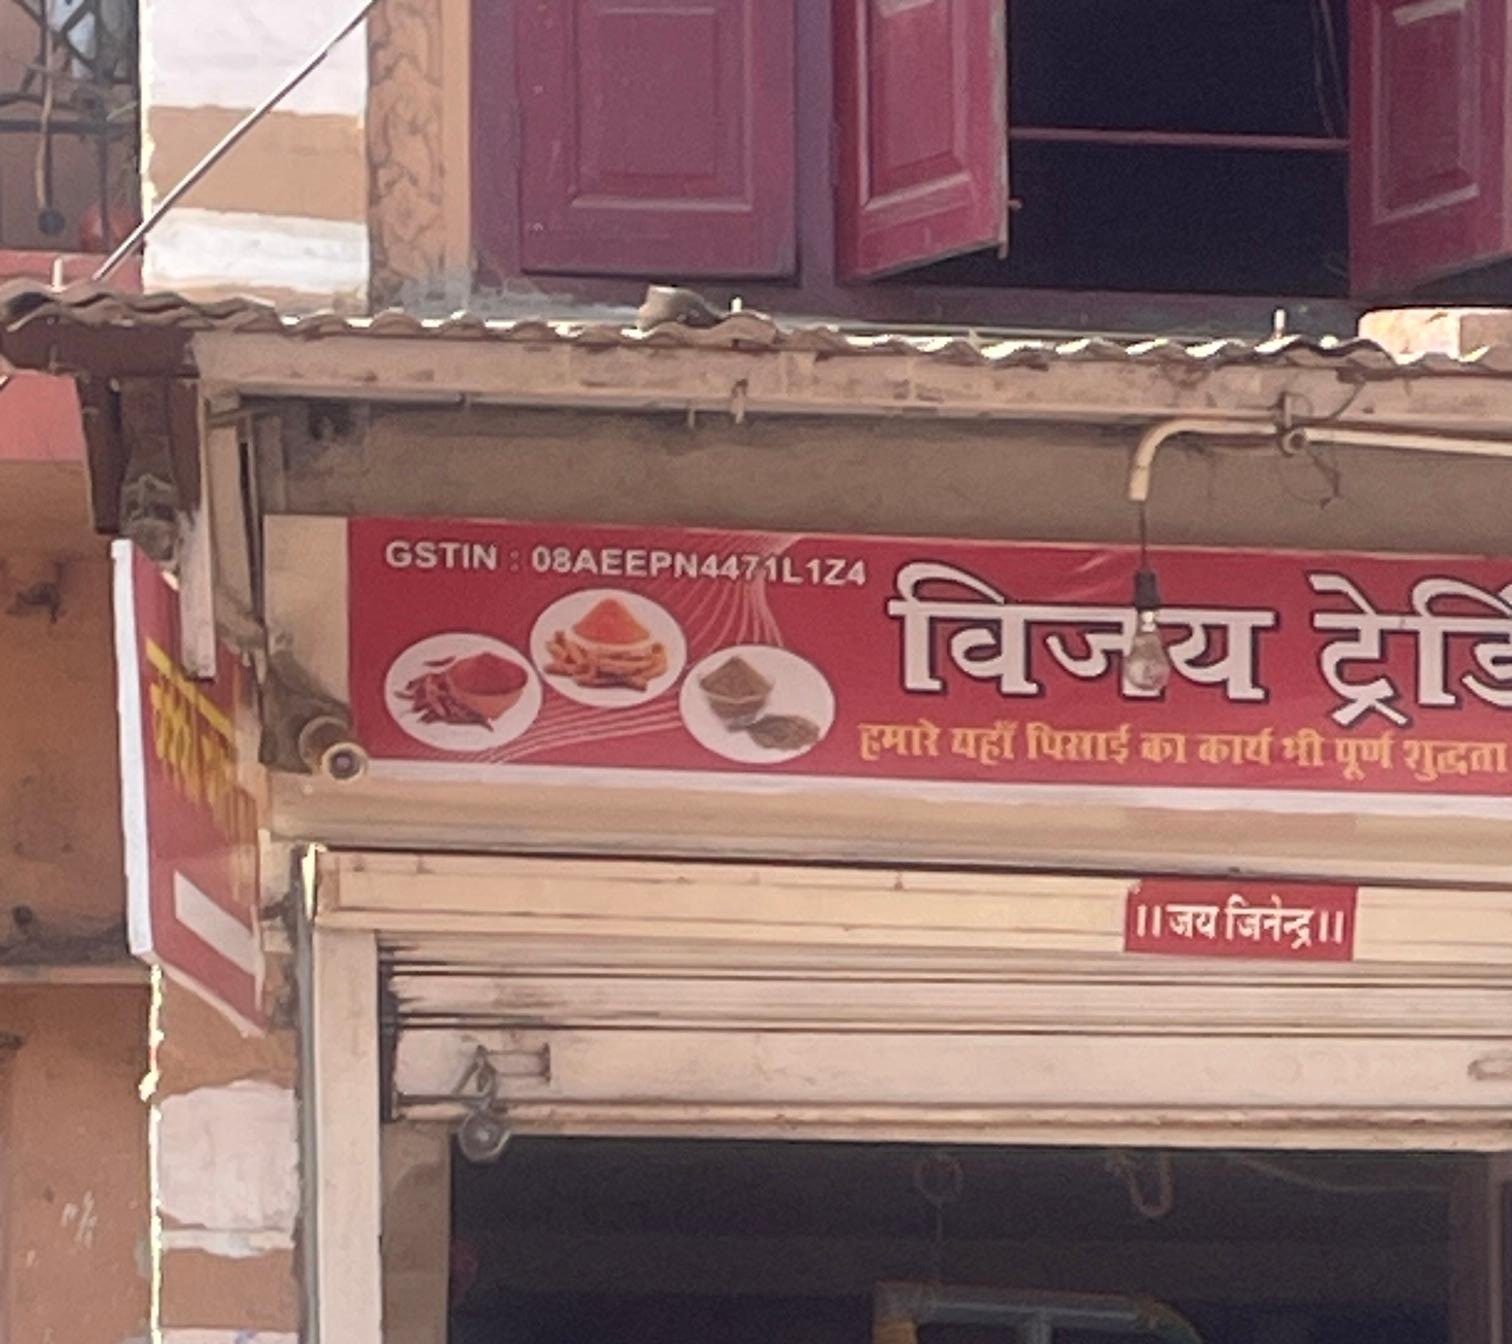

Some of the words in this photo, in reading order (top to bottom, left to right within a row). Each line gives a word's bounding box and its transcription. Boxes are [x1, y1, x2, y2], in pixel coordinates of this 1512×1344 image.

[385, 539, 498, 571] GSTIN
[531, 544, 868, 587] 08AEEPN4471L1Z4
[887, 561, 1276, 700] विजय
[857, 717, 941, 761] हमारे
[1025, 721, 1132, 764] पिसाई
[1139, 731, 1188, 764] का
[1197, 726, 1274, 766] कार्य
[1280, 727, 1326, 767] भी
[1334, 730, 1395, 781] पूर्ण
